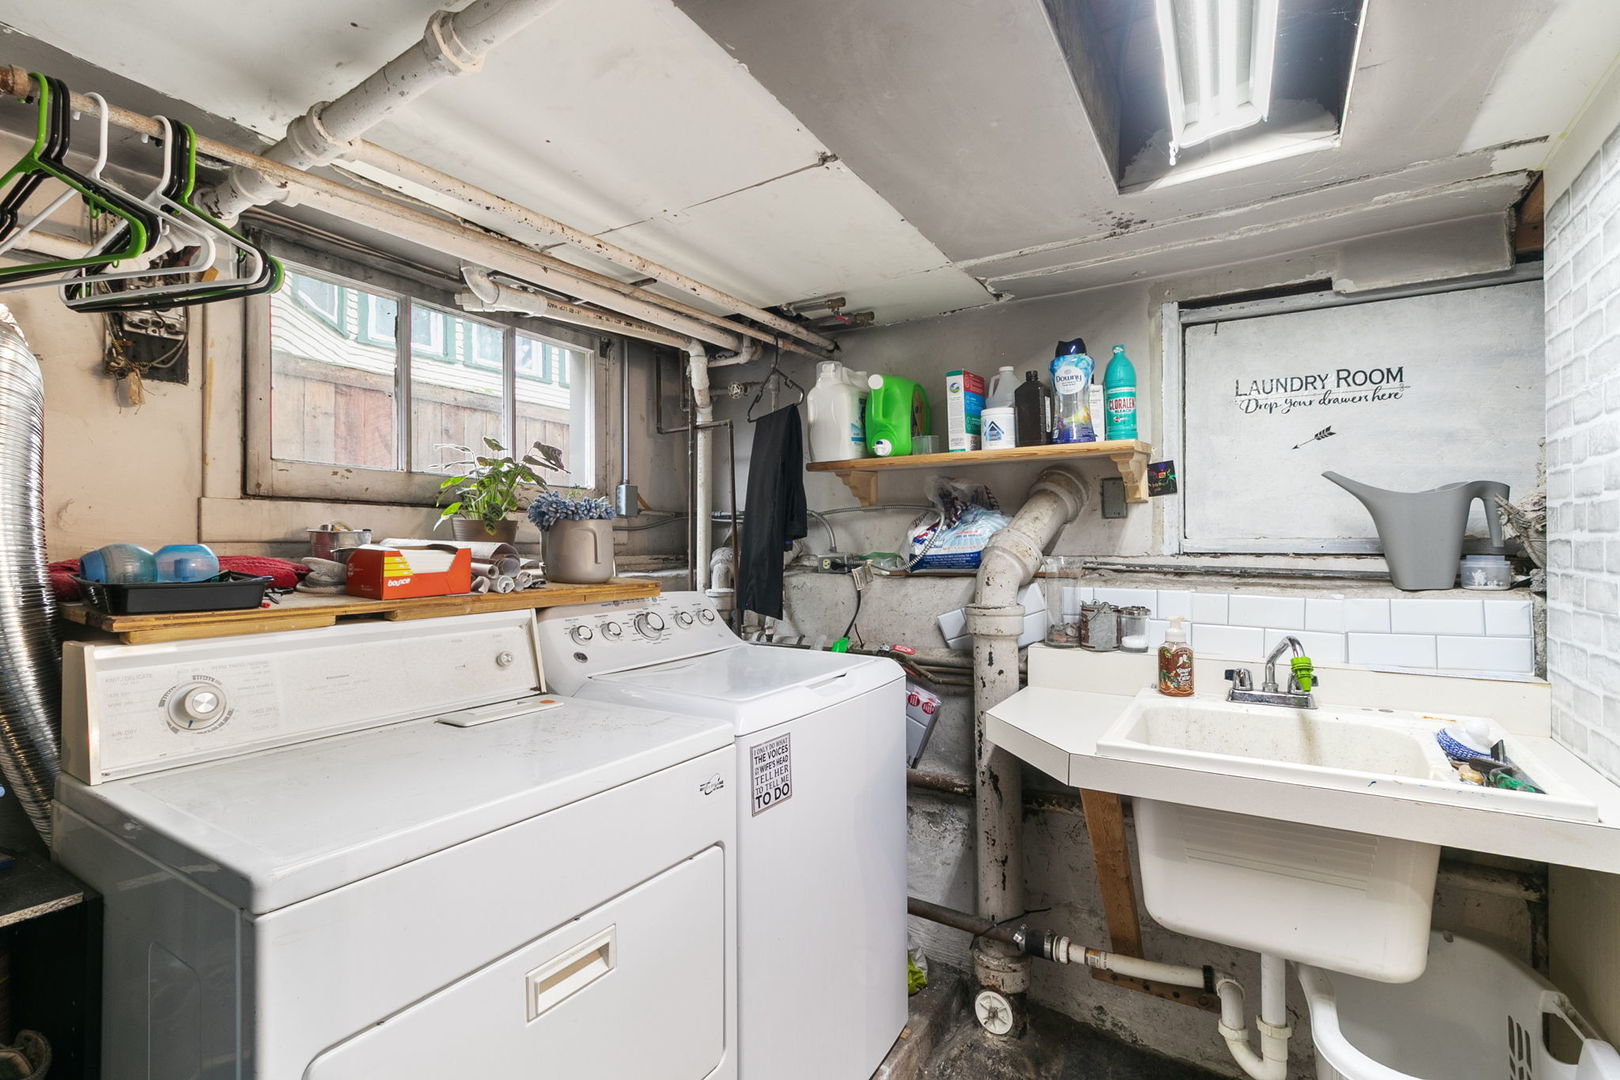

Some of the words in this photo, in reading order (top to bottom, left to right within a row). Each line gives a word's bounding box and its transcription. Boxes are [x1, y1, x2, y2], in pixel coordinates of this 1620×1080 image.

[1055, 375, 1082, 383] Downy
[1235, 374, 1329, 397] LAUNDRY
[1336, 366, 1404, 389] ROOM
[1239, 398, 1281, 415] Drop
[1281, 397, 1313, 415] your
[1318, 389, 1369, 407] drawers
[1371, 386, 1404, 402] here
[387, 577, 411, 587] bounce
[754, 753, 767, 765] THE
[767, 744, 789, 759] VOICES
[756, 745, 768, 755] ONLY
[769, 742, 776, 750] DO
[776, 738, 788, 747] WHAT
[776, 755, 789, 765] HEAD
[754, 771, 774, 786] TELL
[774, 764, 789, 778] HER
[755, 786, 763, 796] TO
[765, 781, 779, 792] TELL
[780, 774, 790, 784] ME
[755, 792, 771, 808] TO
[774, 783, 790, 801] DO
